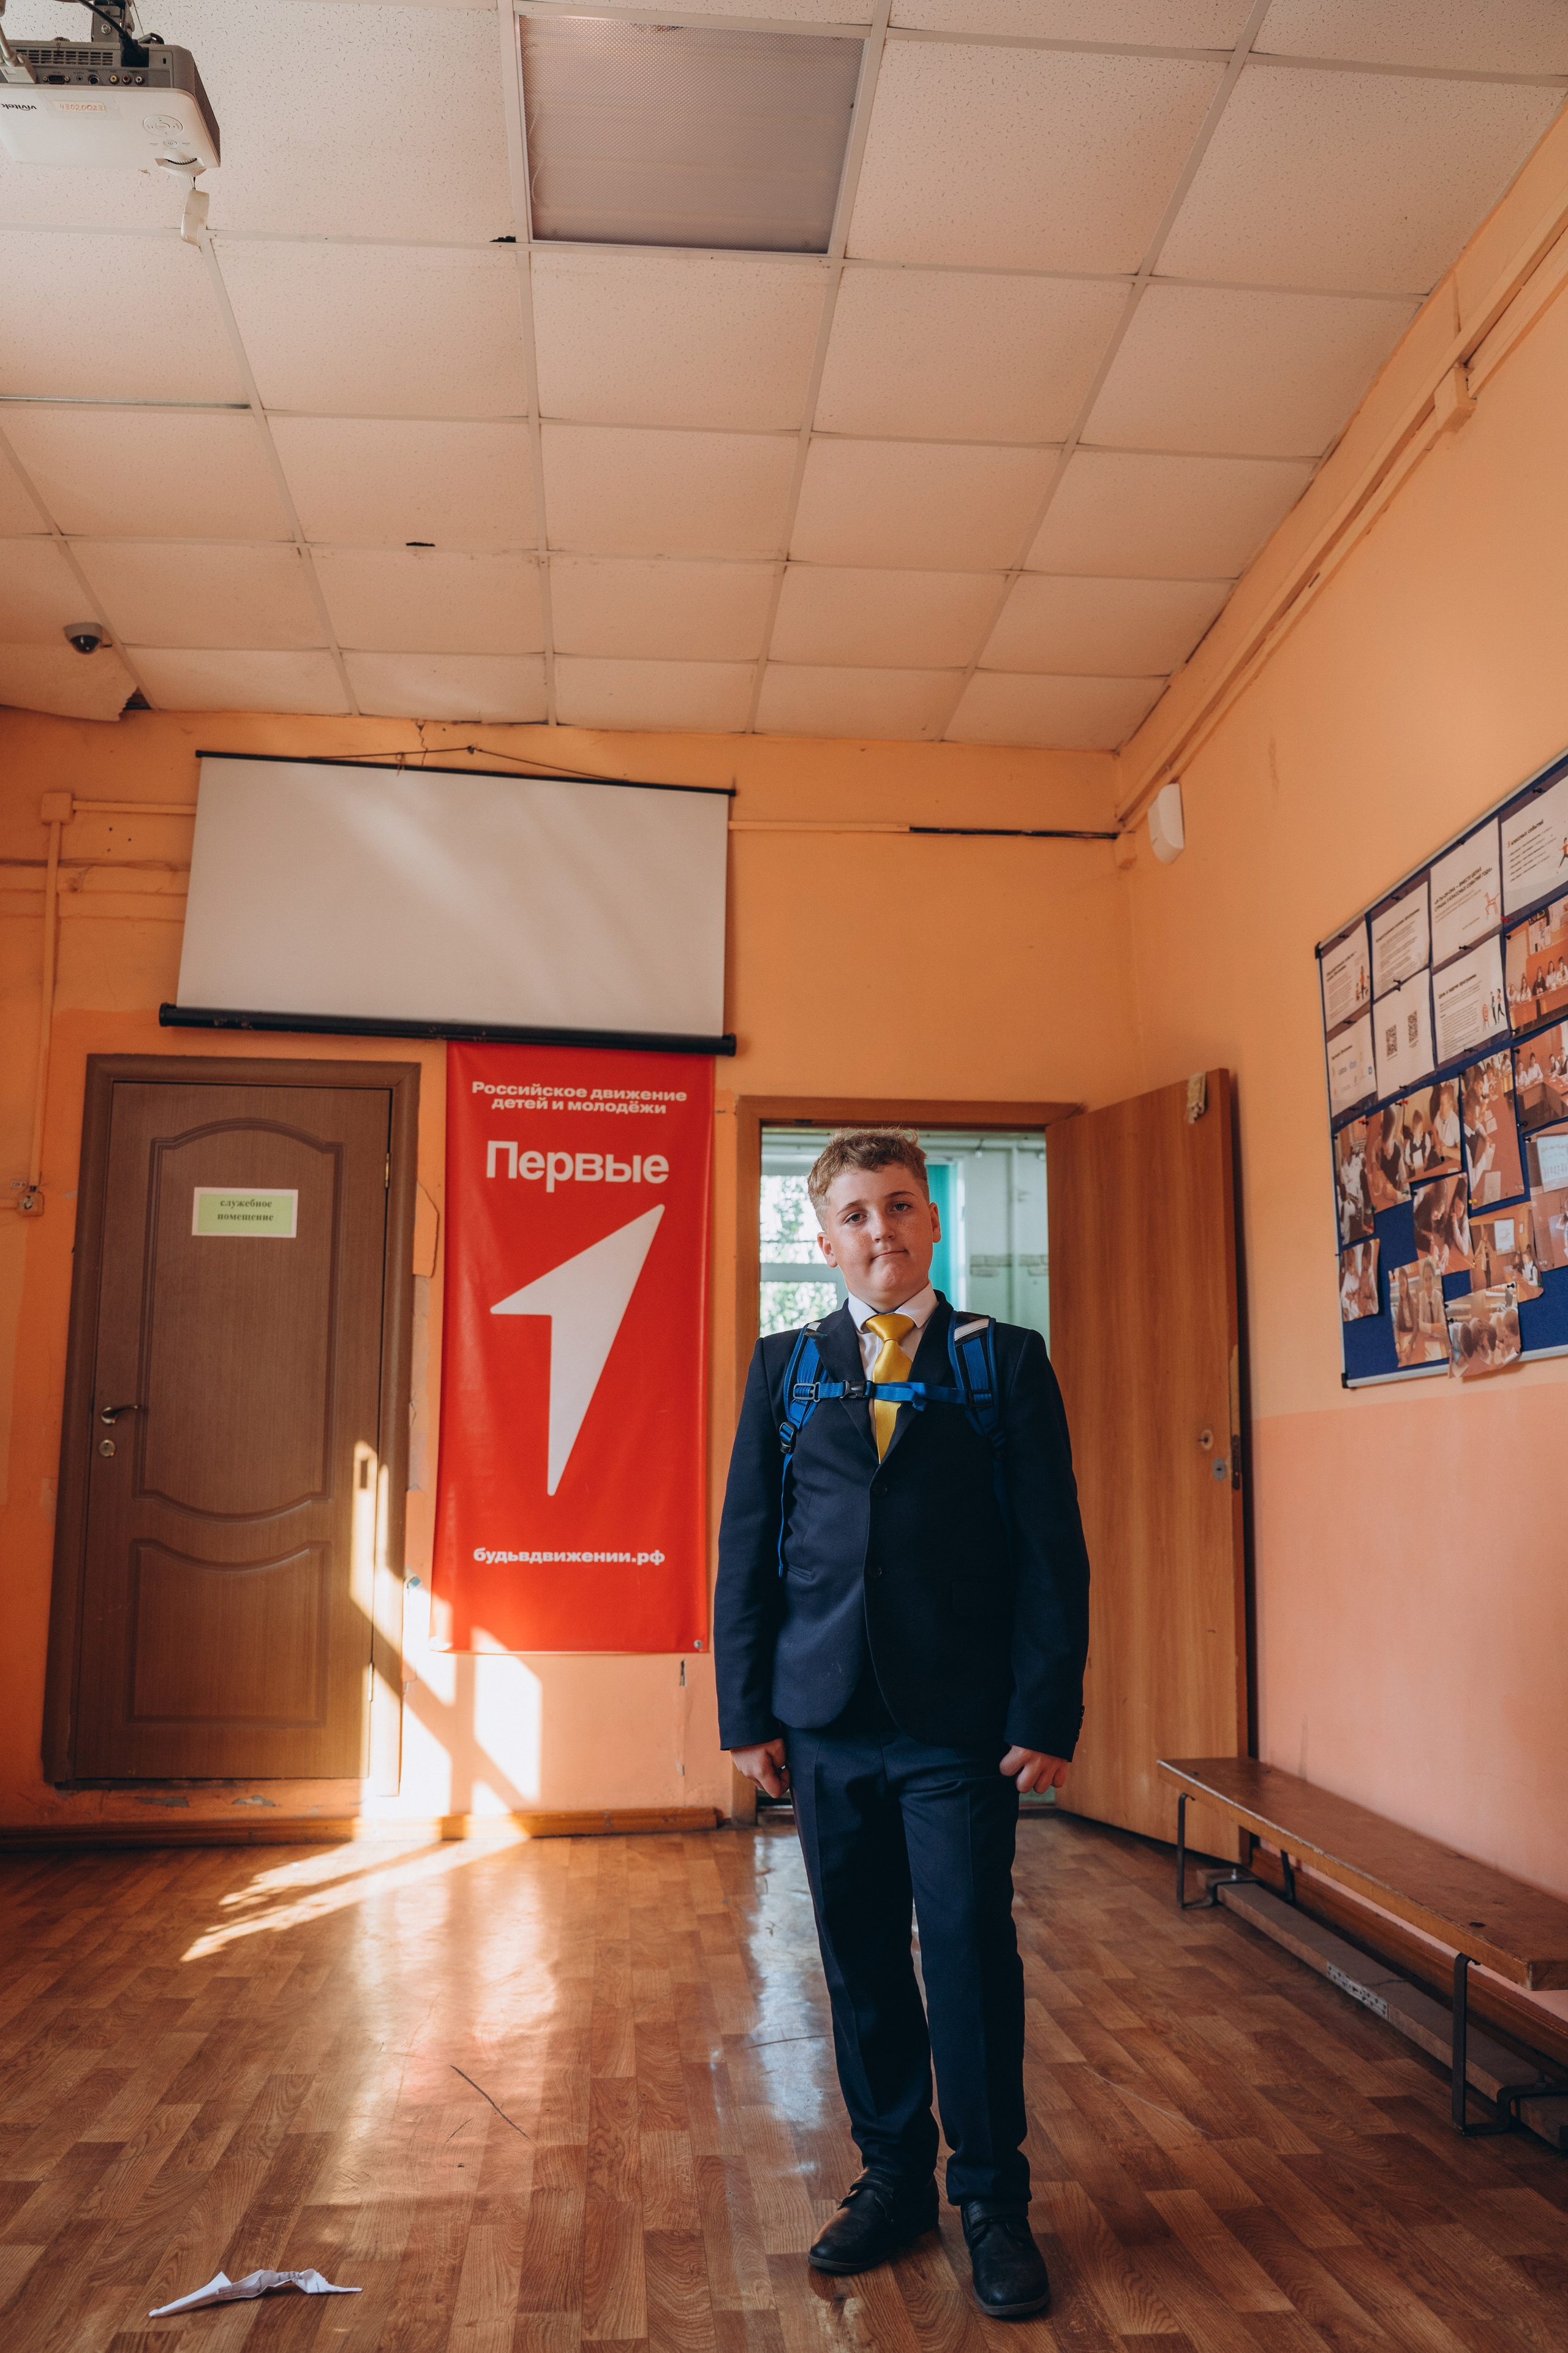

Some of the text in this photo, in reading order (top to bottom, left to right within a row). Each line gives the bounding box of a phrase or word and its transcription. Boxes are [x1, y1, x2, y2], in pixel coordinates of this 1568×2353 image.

[59, 103, 104, 111] 43020023
[472, 1081, 687, 1102] Российское движение
[491, 1097, 666, 1114] детей и молодёжи
[486, 1140, 669, 1193] Первые
[220, 1199, 273, 1209] служебное
[217, 1212, 274, 1222] помещение
[473, 1547, 666, 1566] будьвдвижении.рф
